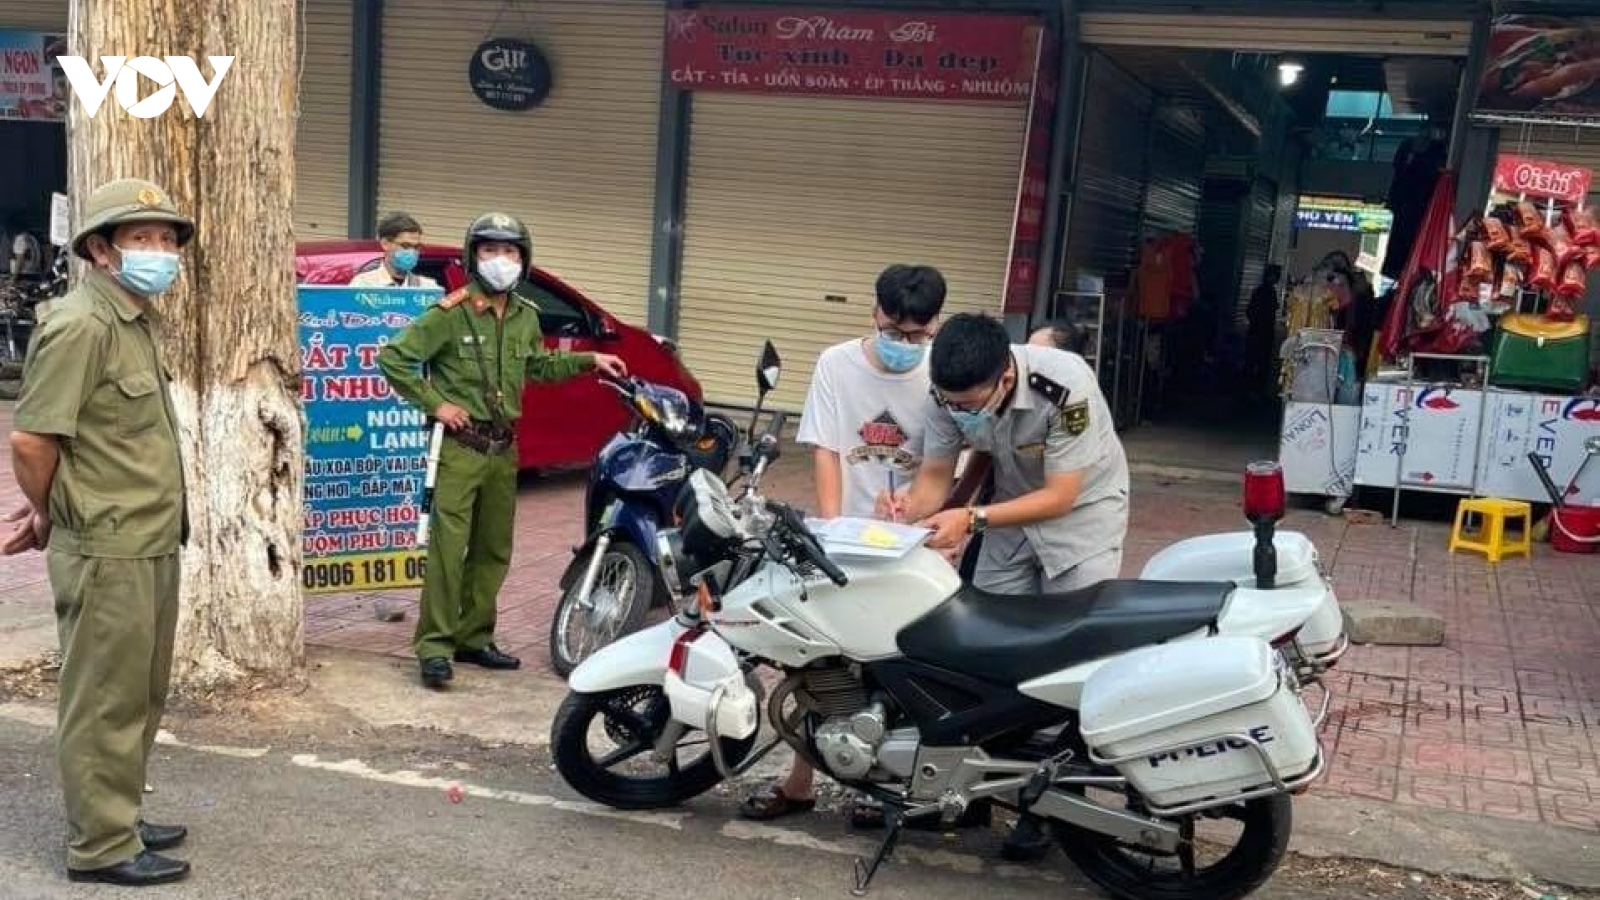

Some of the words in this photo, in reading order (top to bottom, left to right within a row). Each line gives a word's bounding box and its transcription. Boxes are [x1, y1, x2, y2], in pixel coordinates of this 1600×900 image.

[1515, 164, 1570, 194] Oishi
[301, 331, 351, 370] ẮT
[323, 375, 403, 403] NHU
[367, 405, 427, 427] NÓN
[1391, 388, 1413, 457] EVER
[328, 507, 382, 530] PHỤC
[303, 530, 345, 557] UỘM
[303, 561, 354, 589] 0906
[361, 557, 396, 583] 181
[405, 556, 427, 580] 06
